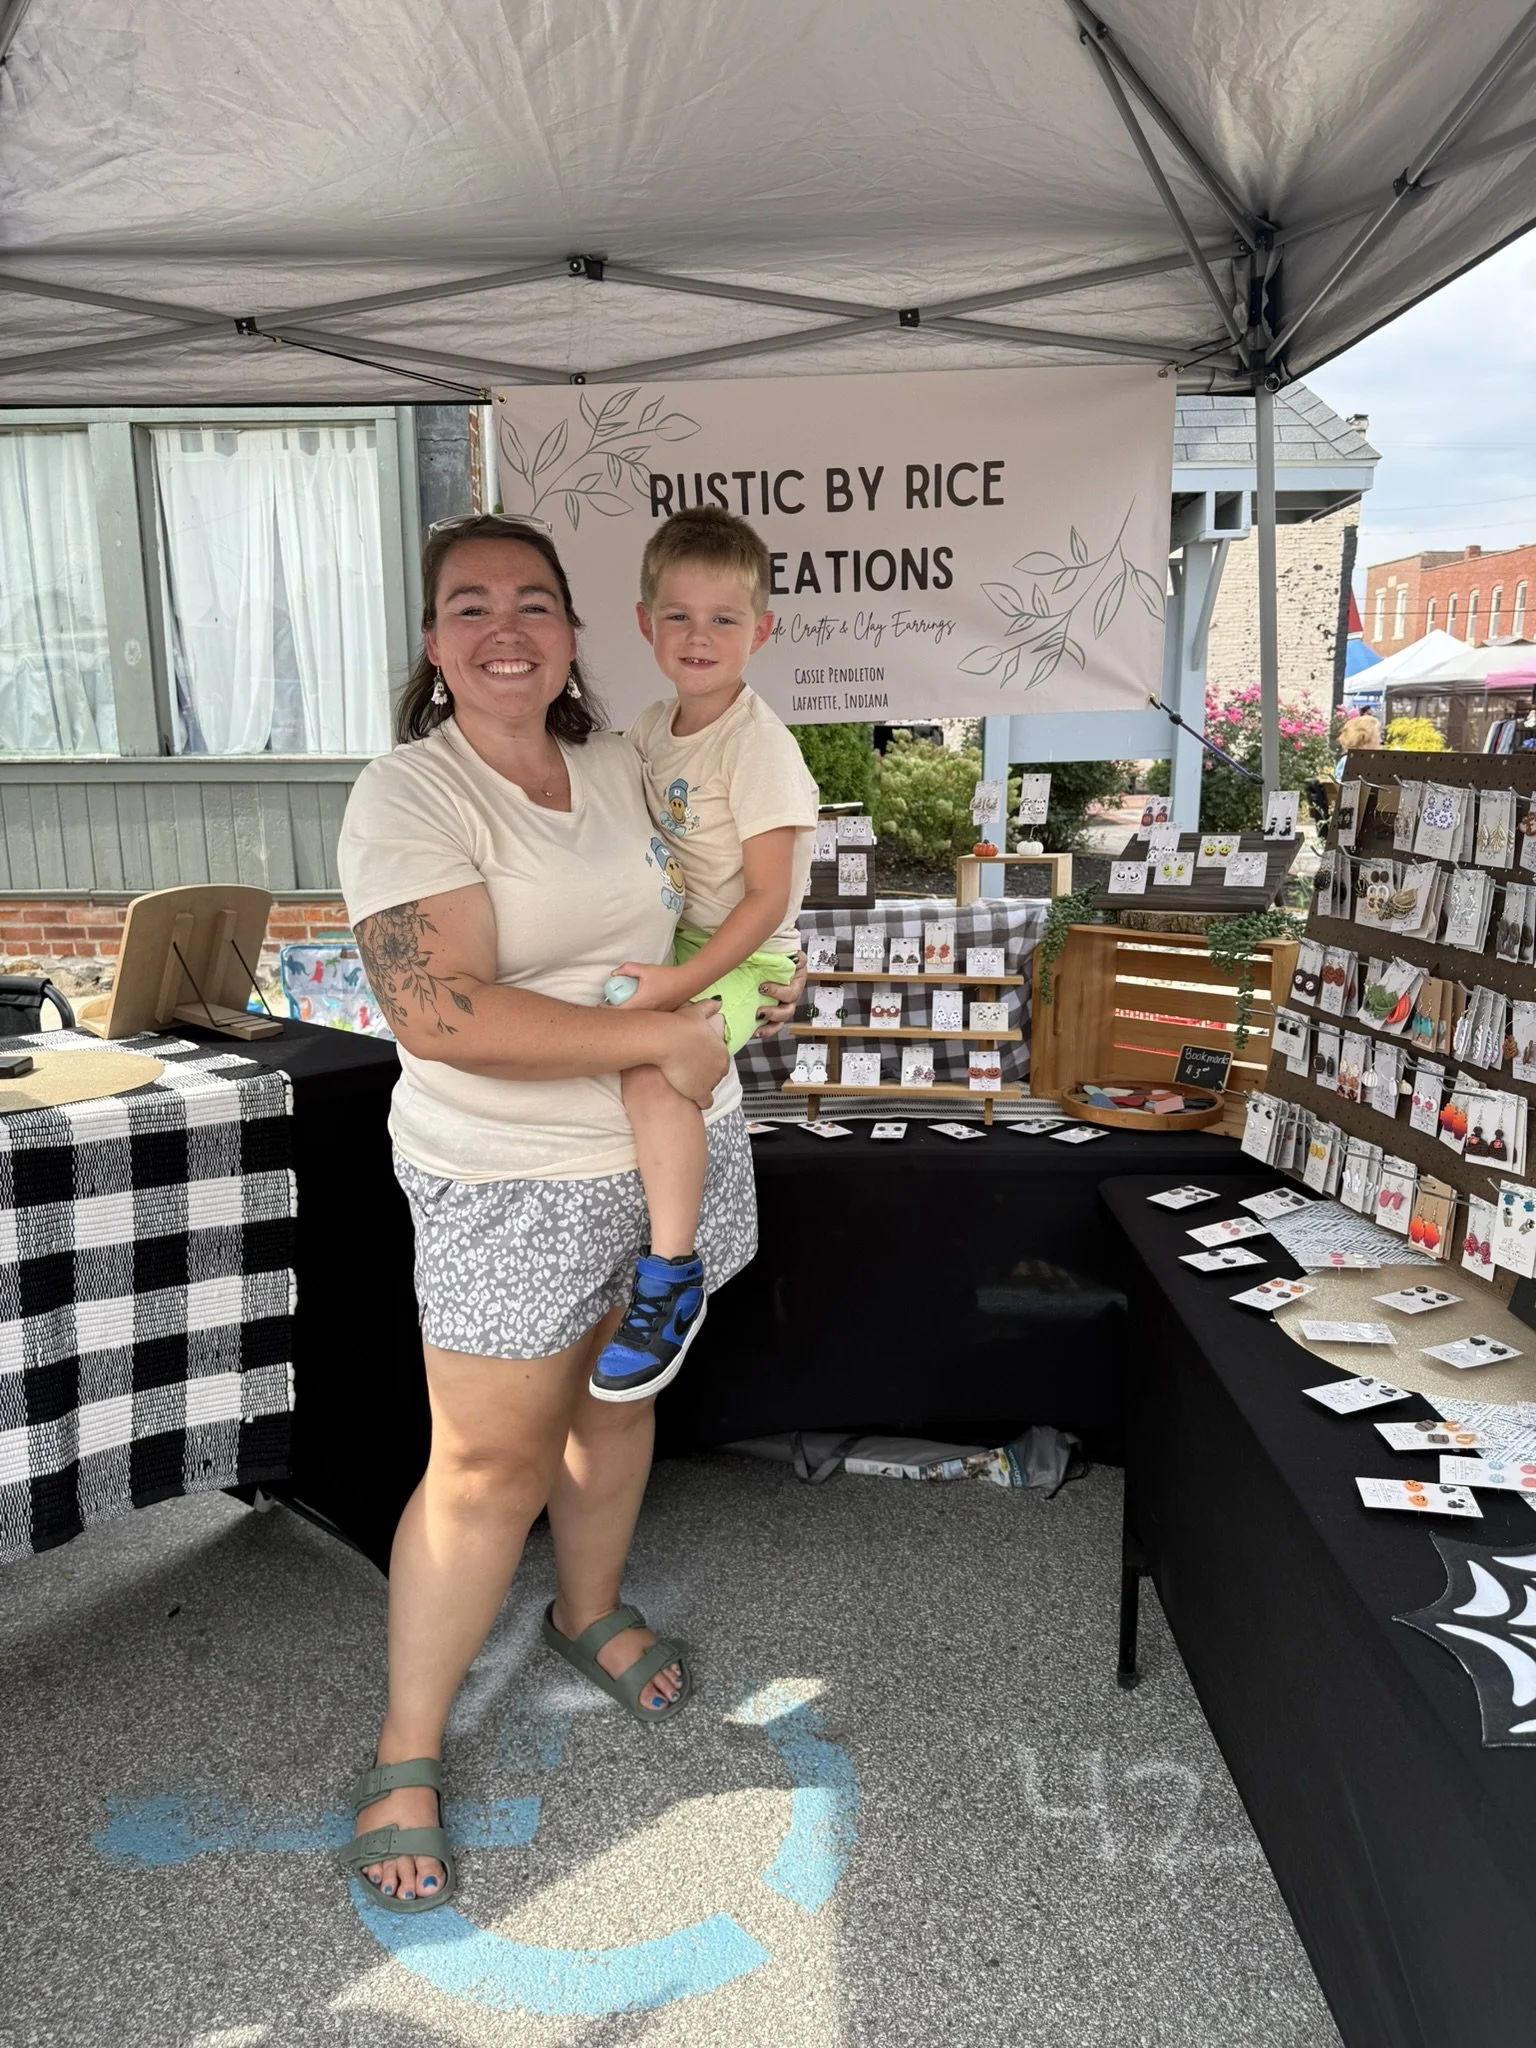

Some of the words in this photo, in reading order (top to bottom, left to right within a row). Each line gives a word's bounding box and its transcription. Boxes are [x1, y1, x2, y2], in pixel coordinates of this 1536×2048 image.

[649, 469, 806, 517] RUSTIC
[826, 466, 884, 512] BY
[906, 460, 1005, 509] RICE
[770, 546, 954, 595] EATIONS
[791, 612, 839, 646] Crafts
[839, 620, 848, 634] &
[854, 610, 887, 648] Clay
[892, 609, 957, 645] Earrings
